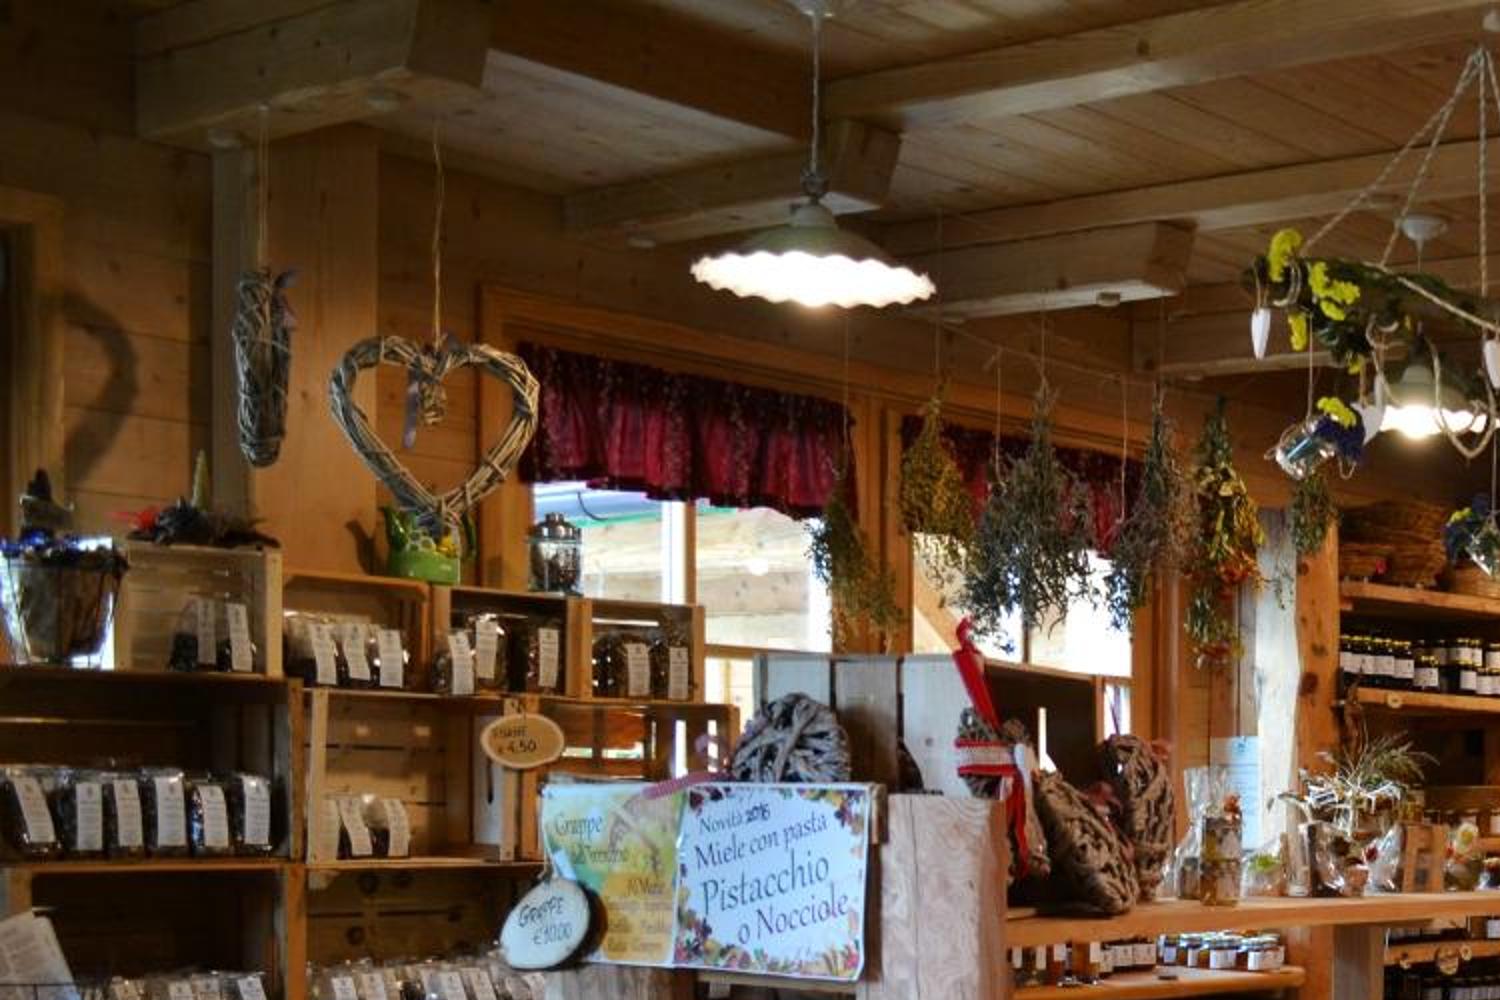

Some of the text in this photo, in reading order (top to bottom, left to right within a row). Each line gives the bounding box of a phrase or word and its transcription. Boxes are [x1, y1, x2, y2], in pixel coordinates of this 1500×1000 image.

[694, 811, 828, 870] Miele con pasta
[700, 811, 744, 833] Novità
[701, 848, 830, 917] Pistacchio
[737, 880, 850, 945] o Nocciole
